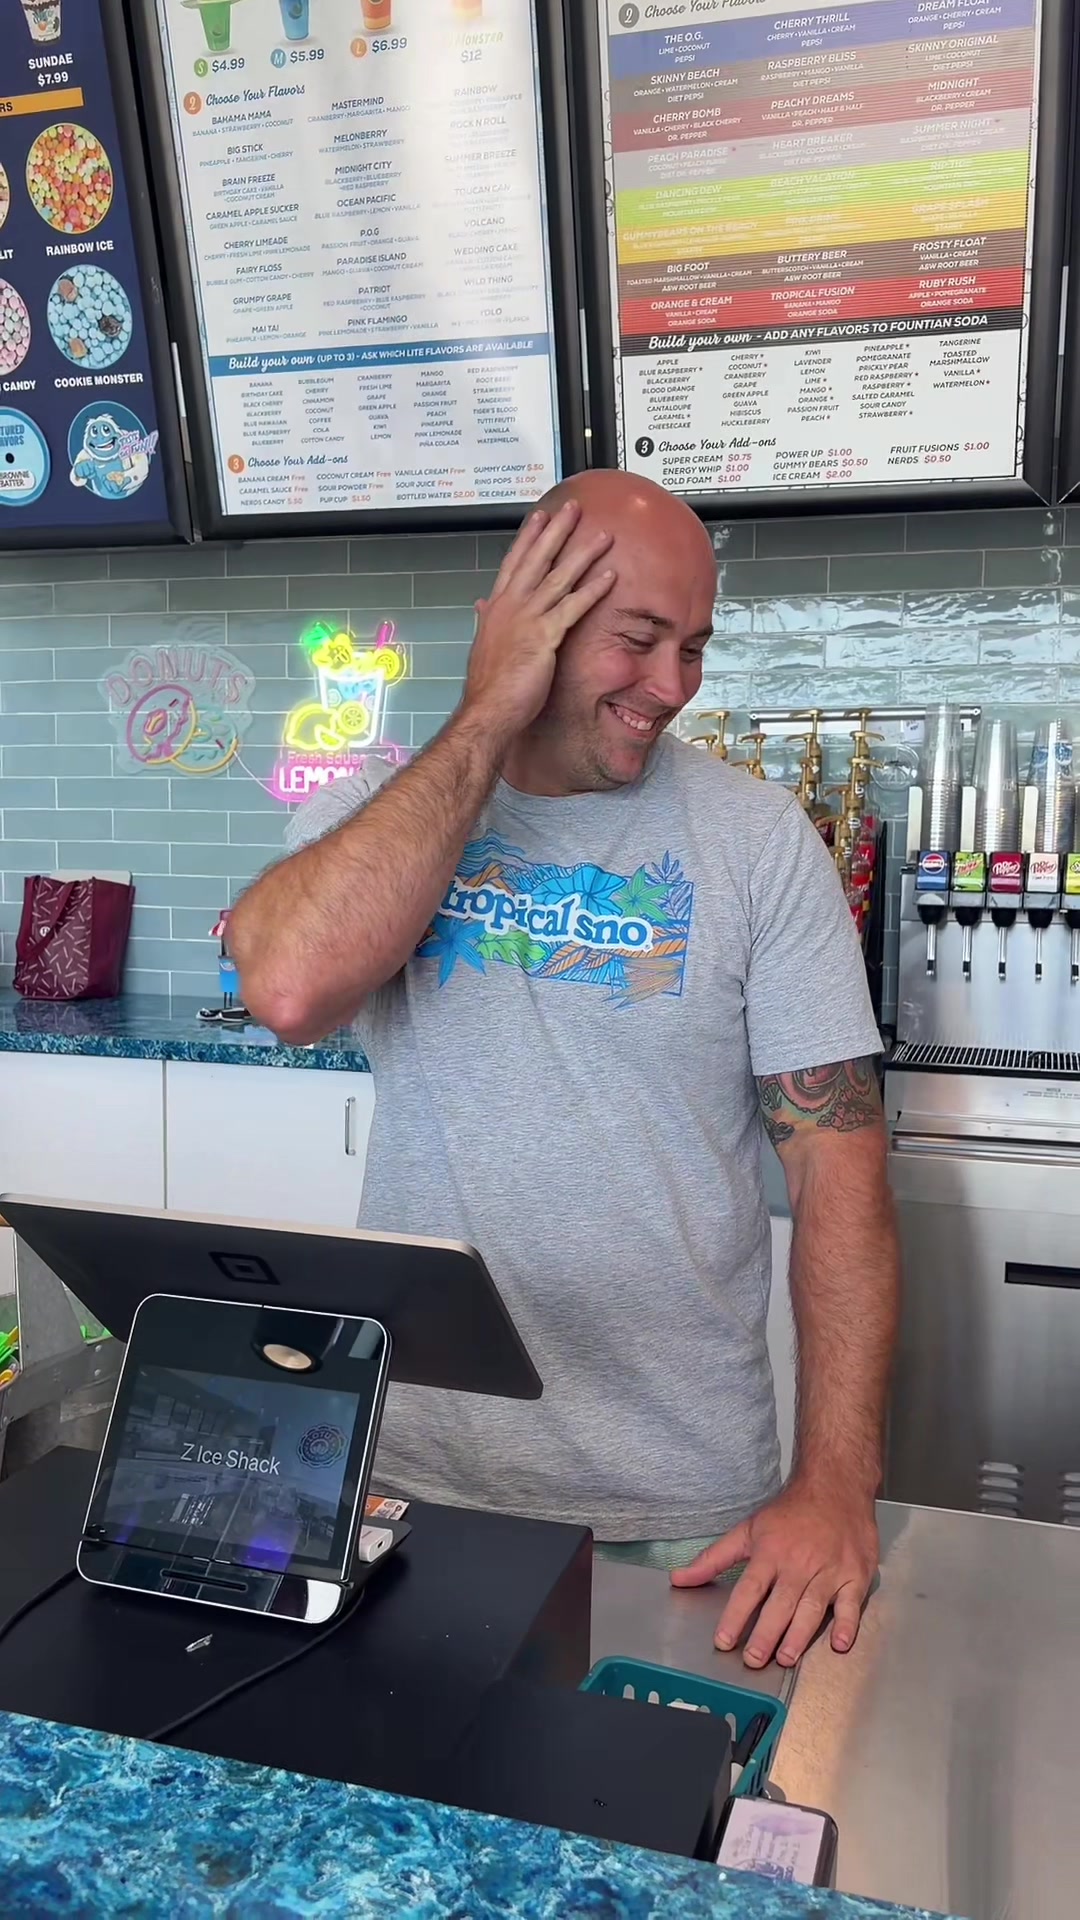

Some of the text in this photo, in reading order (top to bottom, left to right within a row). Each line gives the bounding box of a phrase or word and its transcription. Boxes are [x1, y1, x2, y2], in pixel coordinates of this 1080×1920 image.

[625, 8, 633, 24] 2
[645, 5, 686, 19] Choose
[774, 12, 850, 30] CHERRY THRILL
[943, 21, 966, 30] PEPSI
[664, 31, 704, 45] THE O.G.
[908, 35, 999, 53] SKINNY ORIGINAL
[371, 37, 407, 54] $6.99
[28, 53, 73, 70] SUNDAE
[272, 48, 325, 65] M $5.99
[461, 49, 482, 63] $12
[767, 51, 856, 70] RASPBERRY BLISS
[196, 58, 245, 75] S $4.99
[38, 71, 69, 87] $7.99
[651, 68, 720, 85] SKINNY BEACH
[928, 77, 979, 91] MIDNIGHT
[189, 84, 305, 110] 2 Choose Your Flavors
[331, 96, 384, 111] MASTERMIND
[771, 91, 855, 110] PEACHY DREAMS
[212, 110, 272, 125] BAHAMA MAMA
[653, 107, 721, 124] CHERRY BOMB
[333, 129, 388, 143] MELONBERRY
[227, 143, 264, 155] BIG STICK
[335, 161, 392, 175] MIDNIGHT CITY
[222, 173, 276, 187] BRAIN FREEZE
[337, 194, 396, 208] OCEAN PACIFIC
[206, 203, 299, 221] CARAMEL APPLE SUCKER
[46, 240, 114, 257] RAINBOW ICE
[224, 236, 288, 250] CHERRY LIMEADE
[454, 242, 518, 256] WEDDING CAKE
[913, 236, 987, 252] FROSTY FLOAT
[337, 252, 407, 266] PARADISE ISLAND
[777, 250, 848, 264] BUTTERY BEER
[236, 263, 282, 275] FAIRY FLOSS
[667, 262, 710, 274] BIG FOOT
[358, 284, 391, 295] PATRIOT
[919, 276, 976, 289] RUBY RUSH
[233, 293, 292, 305] GRUMPY GRAPE
[771, 286, 855, 301] TROPICAL FUSION
[651, 295, 733, 311] ORANGE & CREAM
[347, 314, 408, 327] PINK FLAMINGO
[648, 314, 988, 351] Build your own ADD ANY FLAVORS TO FOUNTIAN SODA
[939, 338, 981, 347] TANGERINE
[229, 340, 534, 373] Build your own (UP TO 3) ASK WHICH LITE FLAVORS ARE AVAILABLE
[794, 358, 832, 366] LAVENDER
[856, 353, 912, 362] POMEGRANATE
[929, 356, 990, 366] MARSHMALLOW
[3, 380, 36, 392] CANDY
[54, 373, 143, 388] COOKIE MONSTER
[721, 418, 771, 427] HUCKLEBERRY
[641, 437, 777, 453] 3 Choose Your Add-ons
[890, 441, 990, 454] FRUIT FUSIONS $1.00
[662, 453, 752, 466] SUPER CREAM $0.75
[775, 448, 852, 459] POWER UP $1.00
[887, 454, 951, 465] NERDS $0.50
[248, 456, 280, 467] Choose
[283, 456, 304, 466] Your
[307, 455, 348, 465] Add-ons
[773, 458, 868, 470] GUMMY BEARS $0.50
[395, 467, 466, 477] VANILLA CREAM Free
[662, 464, 750, 476] ENERGY WHIP $1.00
[772, 470, 852, 482] ICE CREAM $2.00
[396, 490, 475, 501] BOTTLED WATER $2.00
[105, 646, 248, 706] DONUTS
[287, 750, 322, 765] Fresh
[992, 862, 1021, 876] Pepper
[442, 880, 648, 945] tropical sno
[181, 1443, 195, 1461] Z
[197, 1445, 222, 1466] Ice
[225, 1450, 281, 1475] Shack
